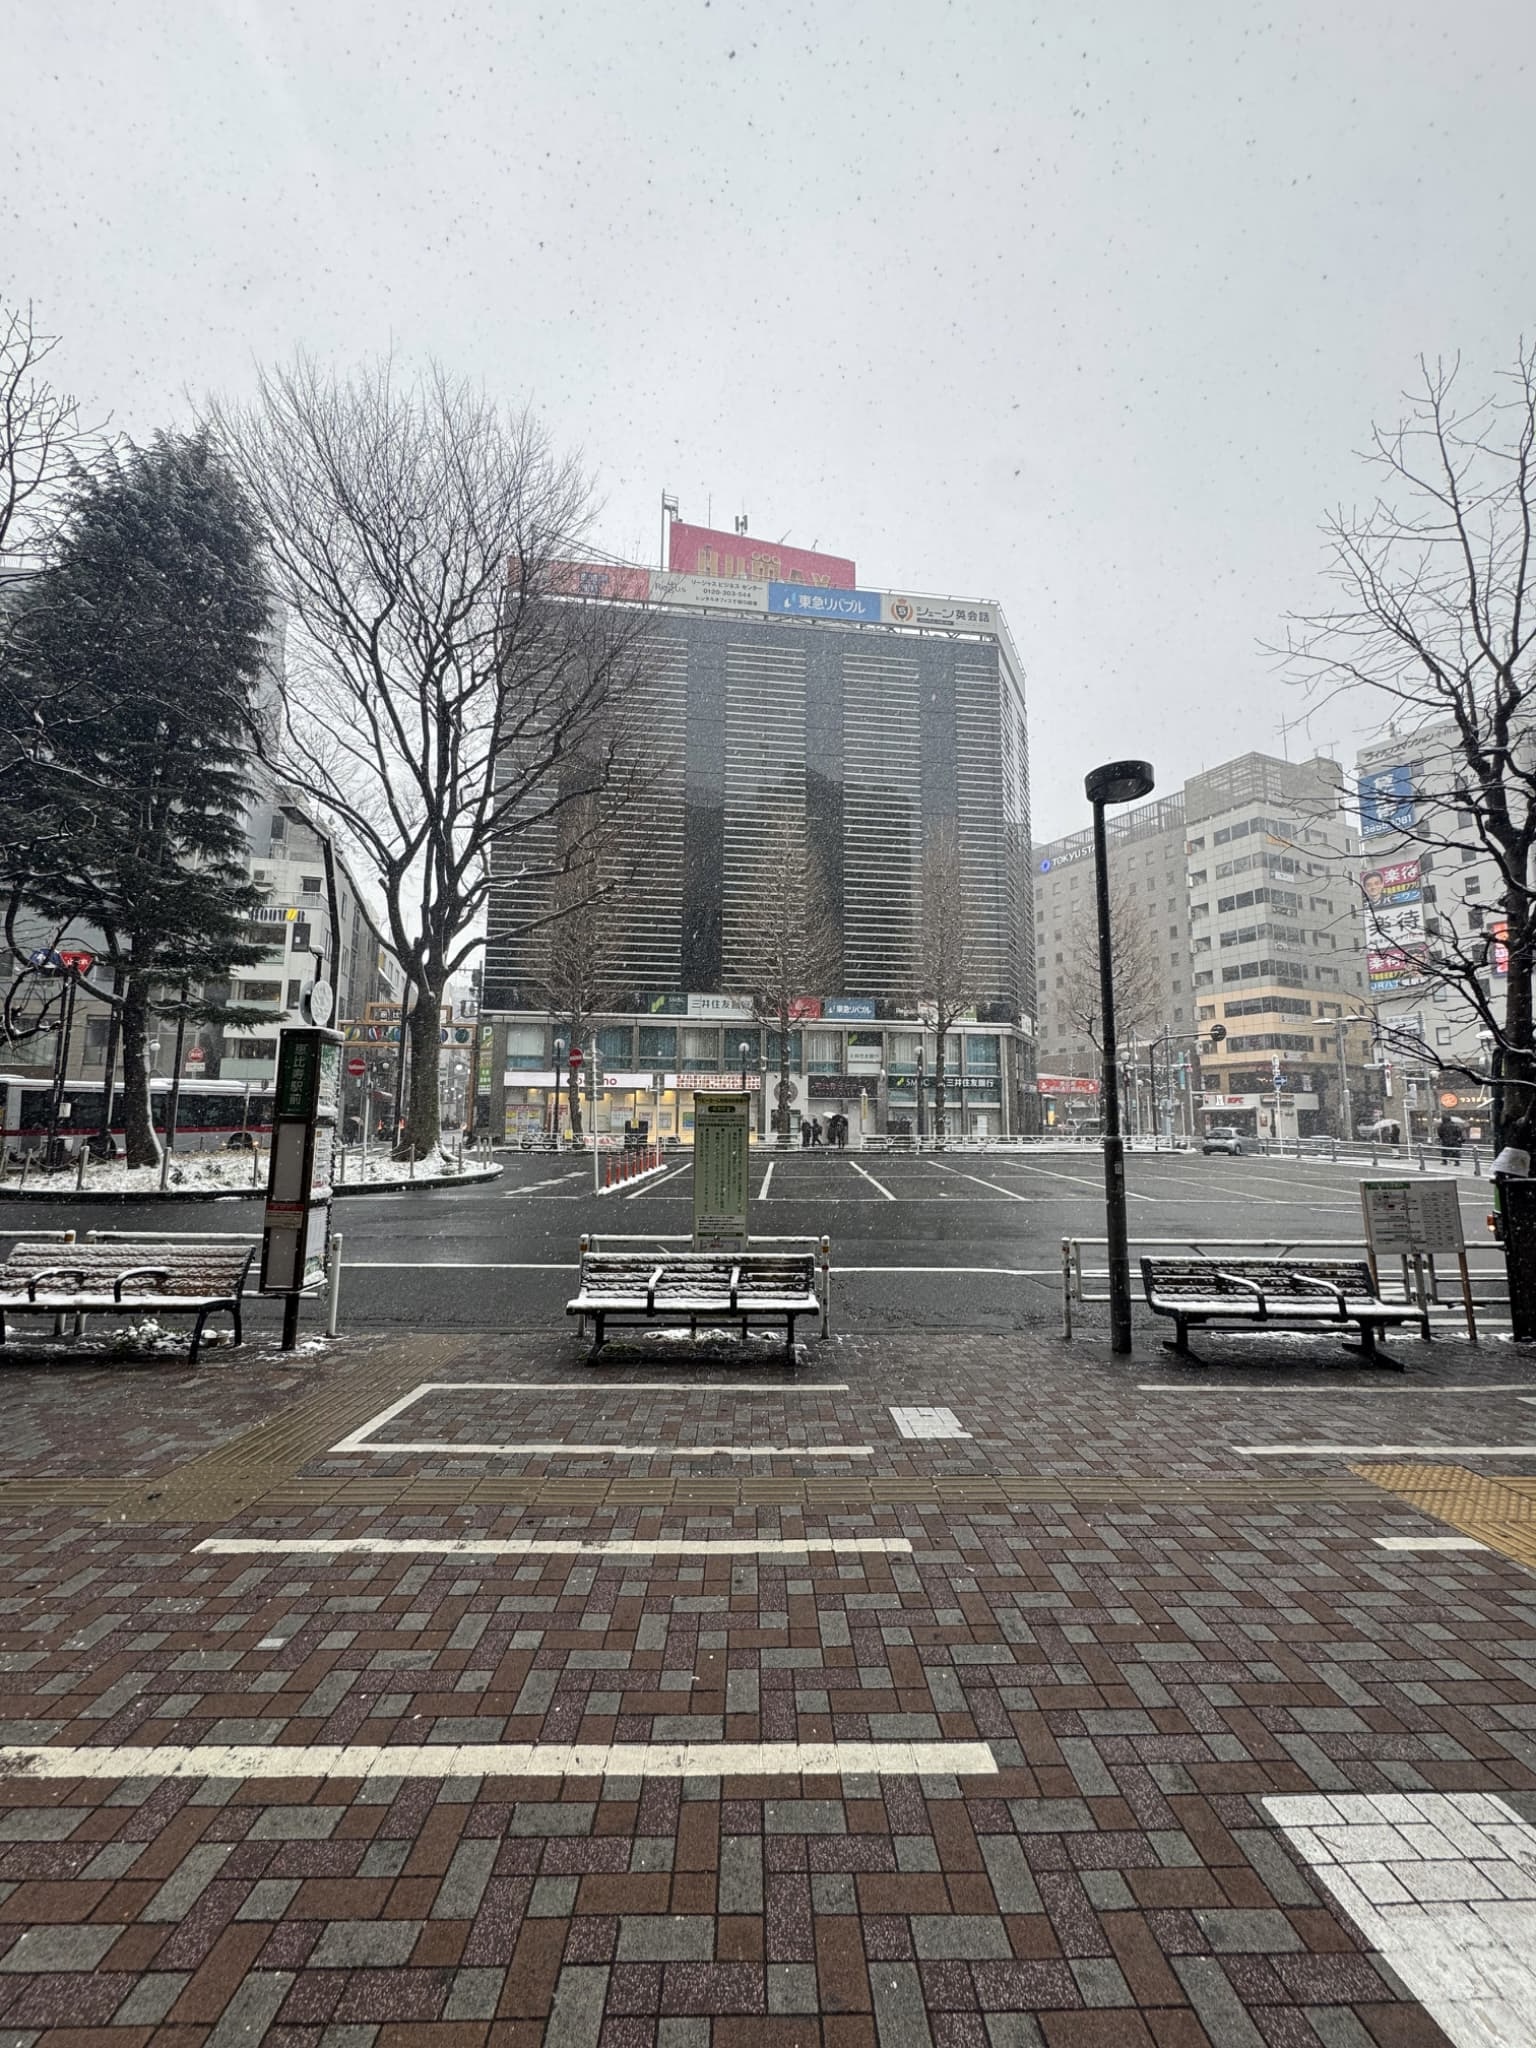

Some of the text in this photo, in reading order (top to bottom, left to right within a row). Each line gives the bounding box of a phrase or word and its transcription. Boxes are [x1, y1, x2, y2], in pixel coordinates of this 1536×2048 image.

[798, 594, 866, 614] 東急リバブル
[916, 606, 990, 623] シェーン英会話
[1052, 849, 1081, 866] TOKYU
[1368, 909, 1421, 937] 楽待
[483, 1026, 493, 1041] P
[288, 1043, 309, 1105] 恵比寿駅前
[906, 1078, 930, 1086] SMC
[945, 1078, 994, 1088] 三井住友銀行
